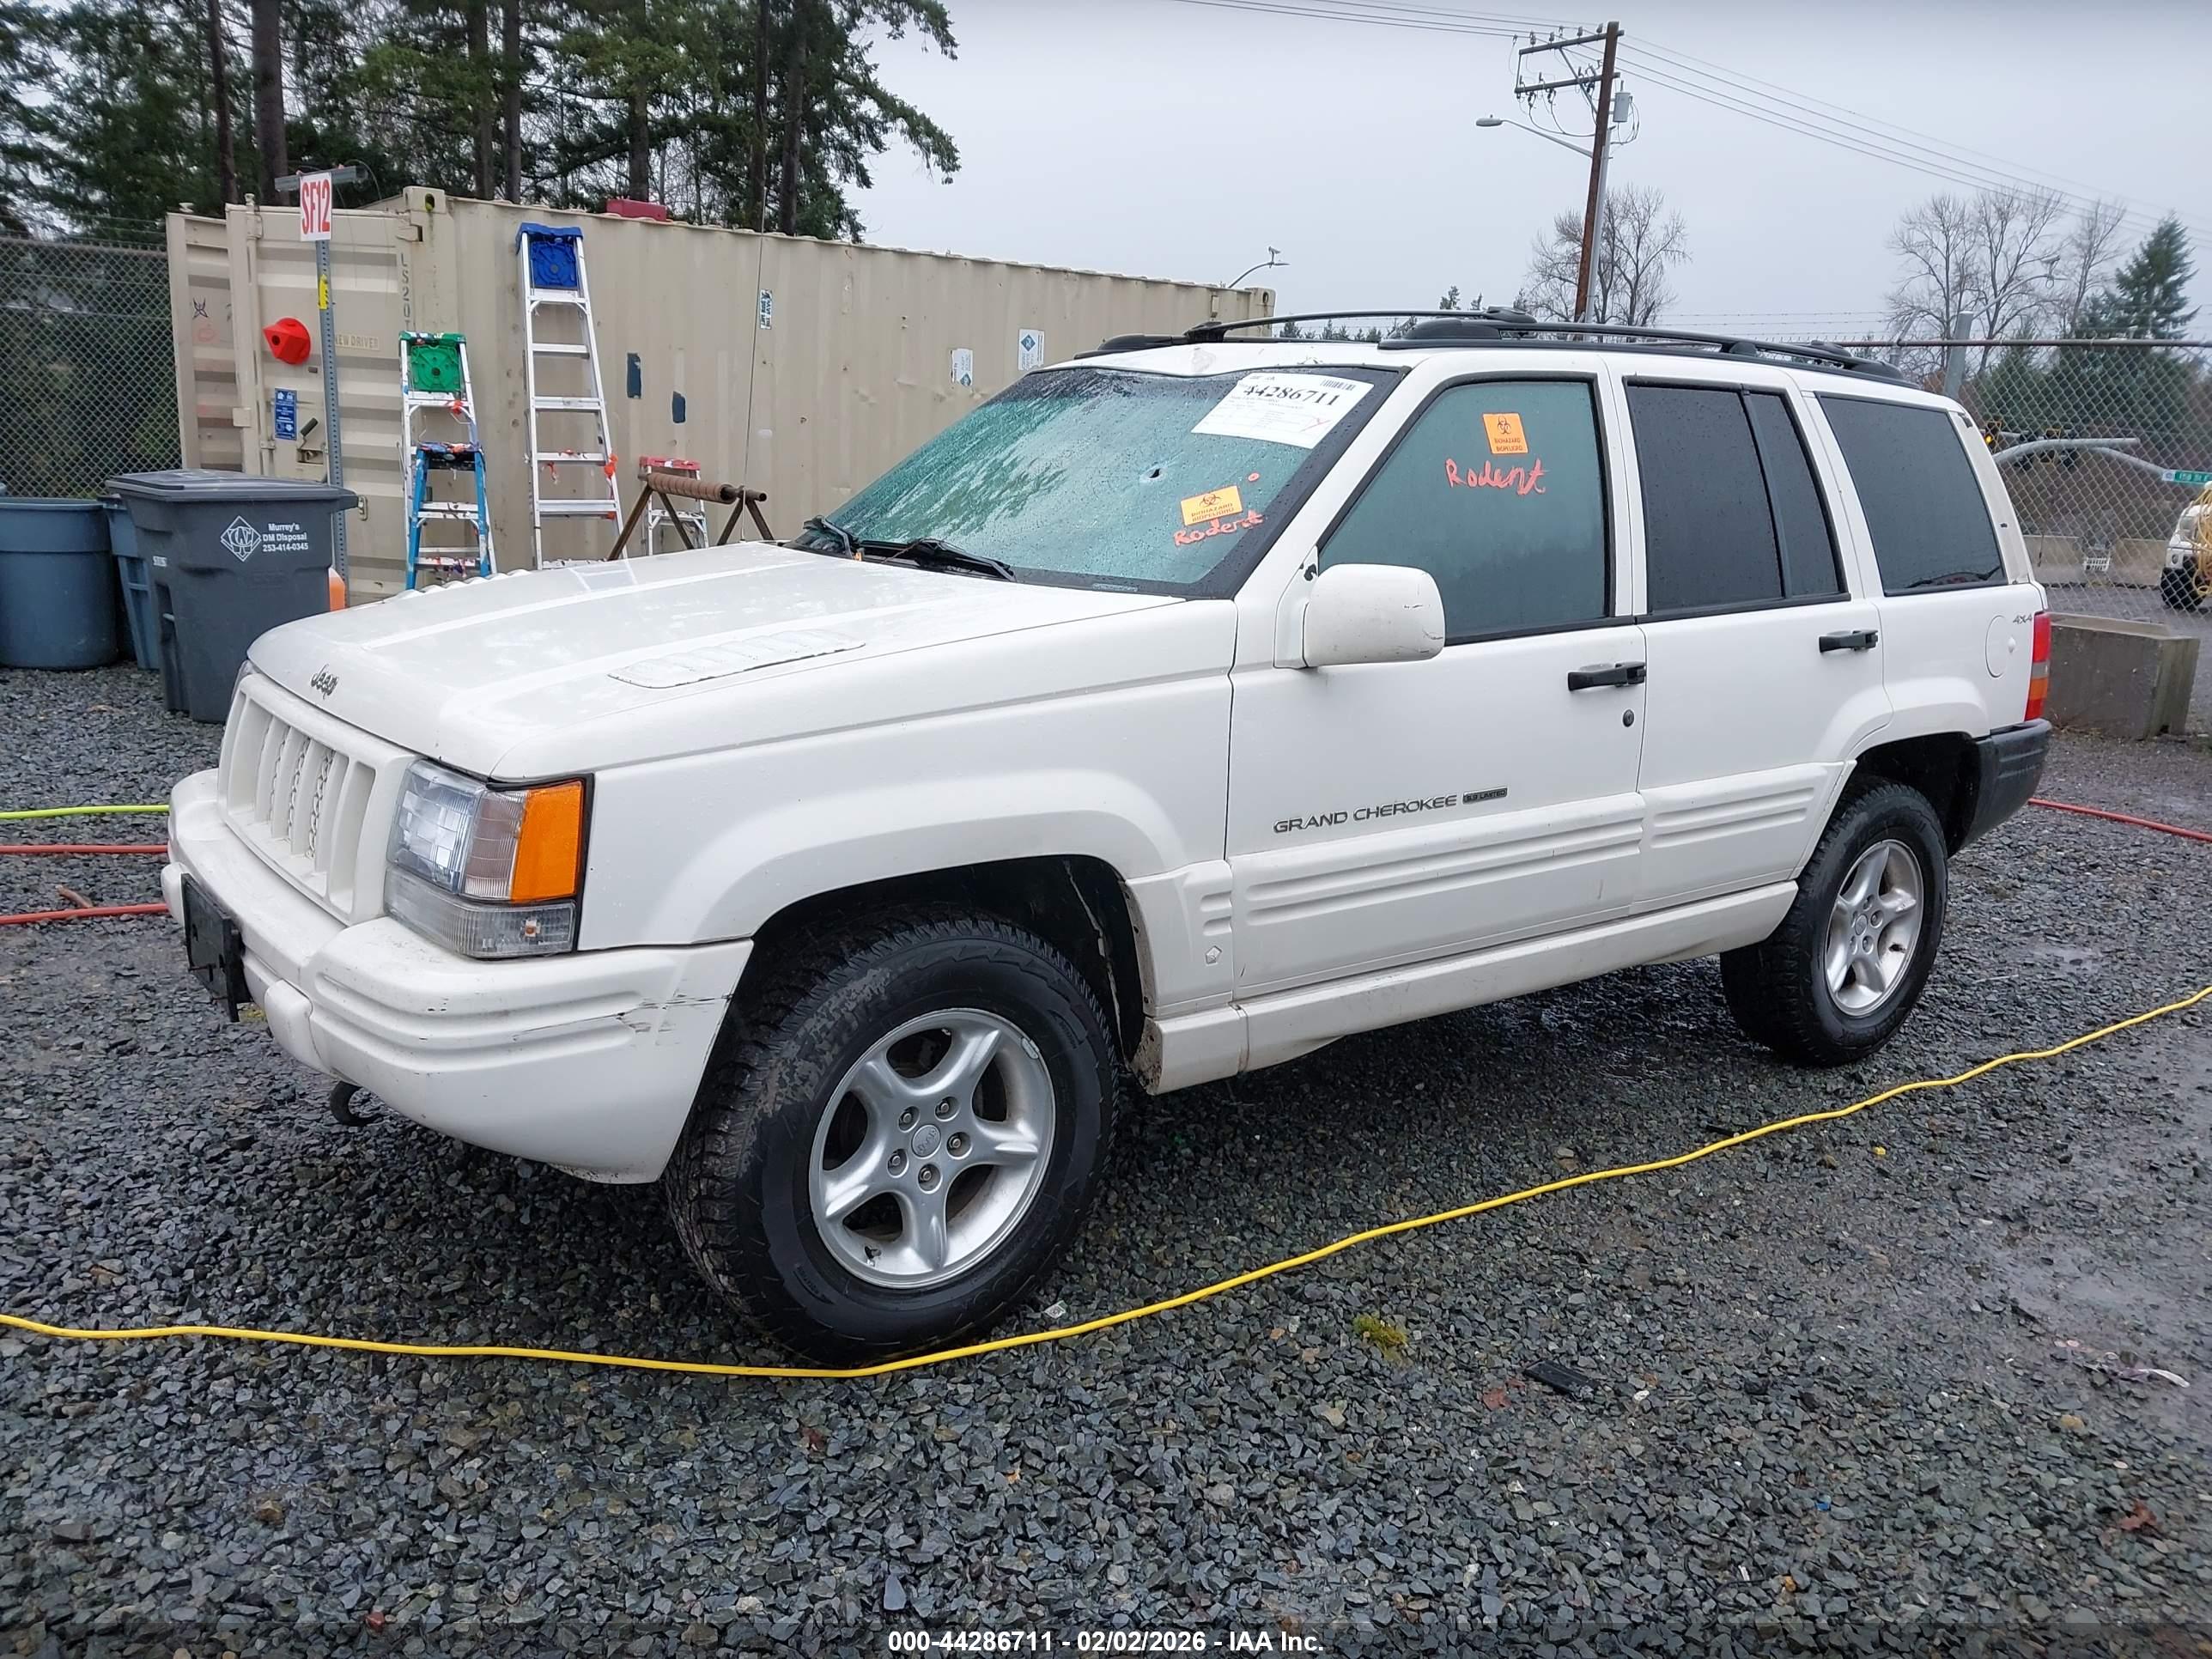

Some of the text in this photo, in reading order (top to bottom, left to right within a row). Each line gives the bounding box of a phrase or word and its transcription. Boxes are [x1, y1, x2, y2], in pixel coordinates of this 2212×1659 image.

[302, 179, 331, 234] SF12
[1243, 385, 1340, 406] 44286711
[1444, 458, 1551, 495] Rodent
[262, 532, 307, 543] DM Disposal
[268, 522, 301, 532] Murrey's
[262, 542, 309, 552] 253-414-0345
[310, 664, 339, 700] Jeep
[1273, 811, 1348, 834] GRAND
[1352, 794, 1458, 822] CHEROKEE
